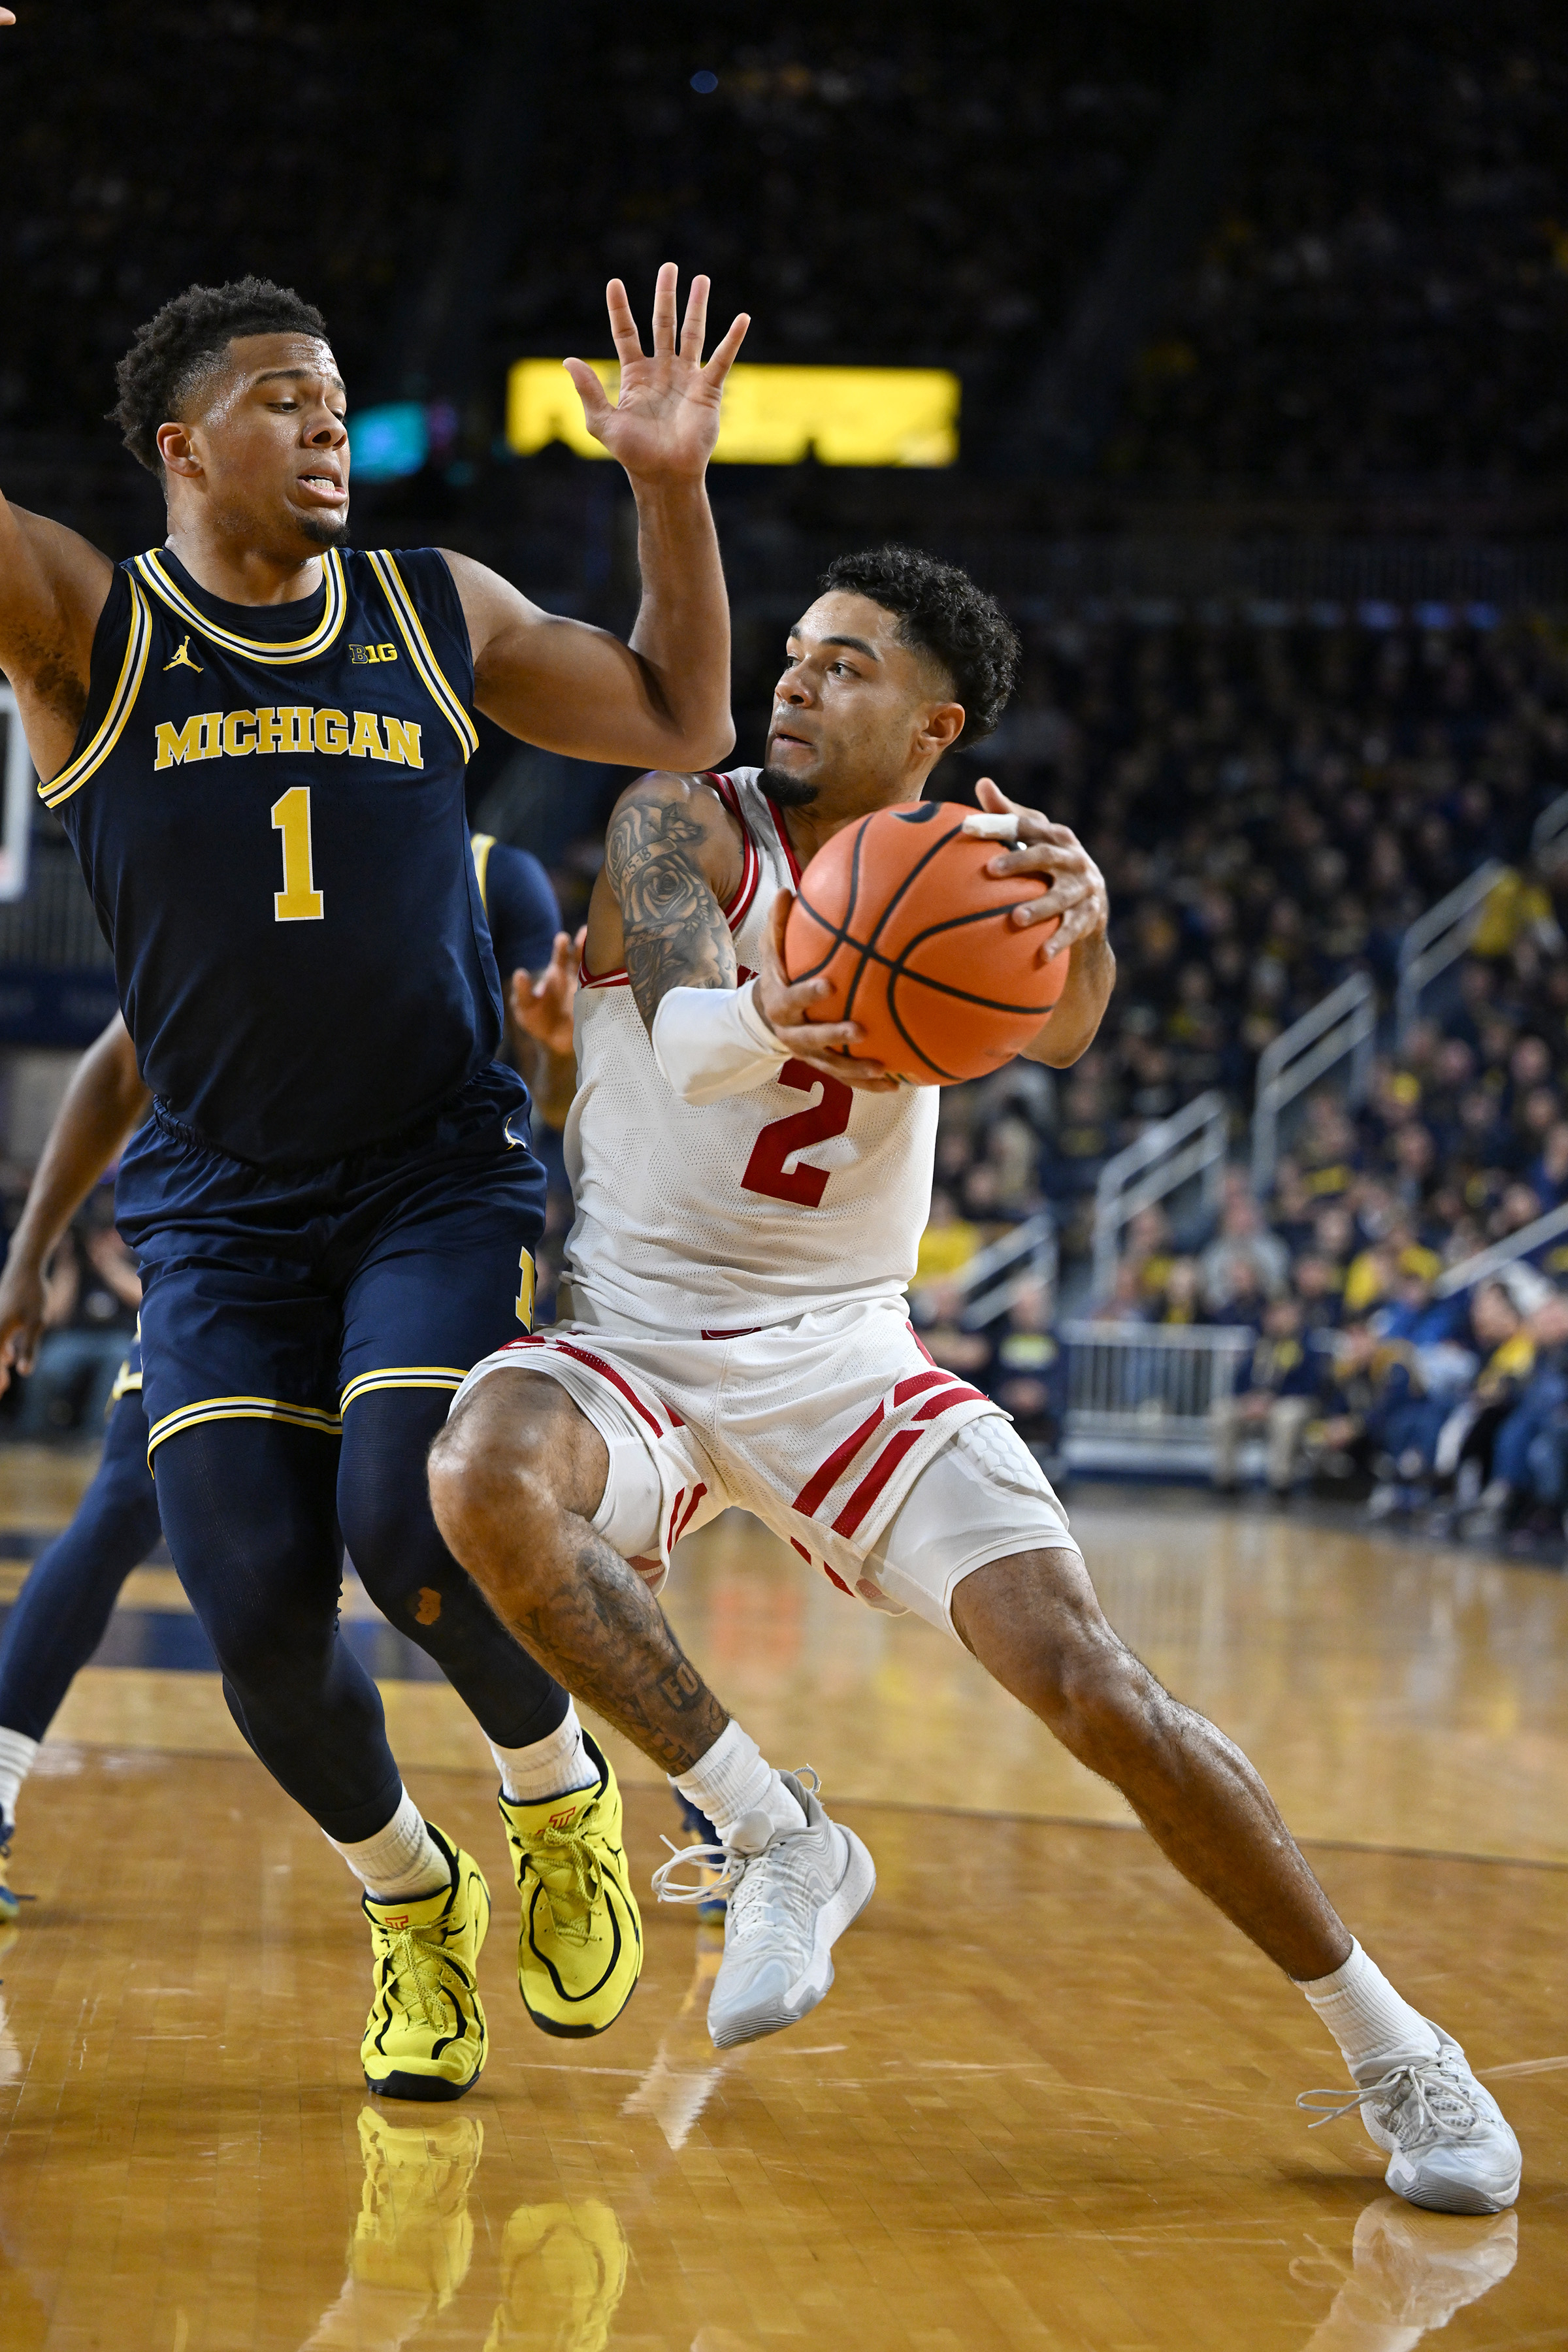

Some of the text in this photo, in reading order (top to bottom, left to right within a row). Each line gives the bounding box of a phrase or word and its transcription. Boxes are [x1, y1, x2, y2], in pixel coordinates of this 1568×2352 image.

[154, 707, 424, 771] MICHIGAN
[270, 787, 324, 922] 1
[740, 1058, 853, 1208] 2
